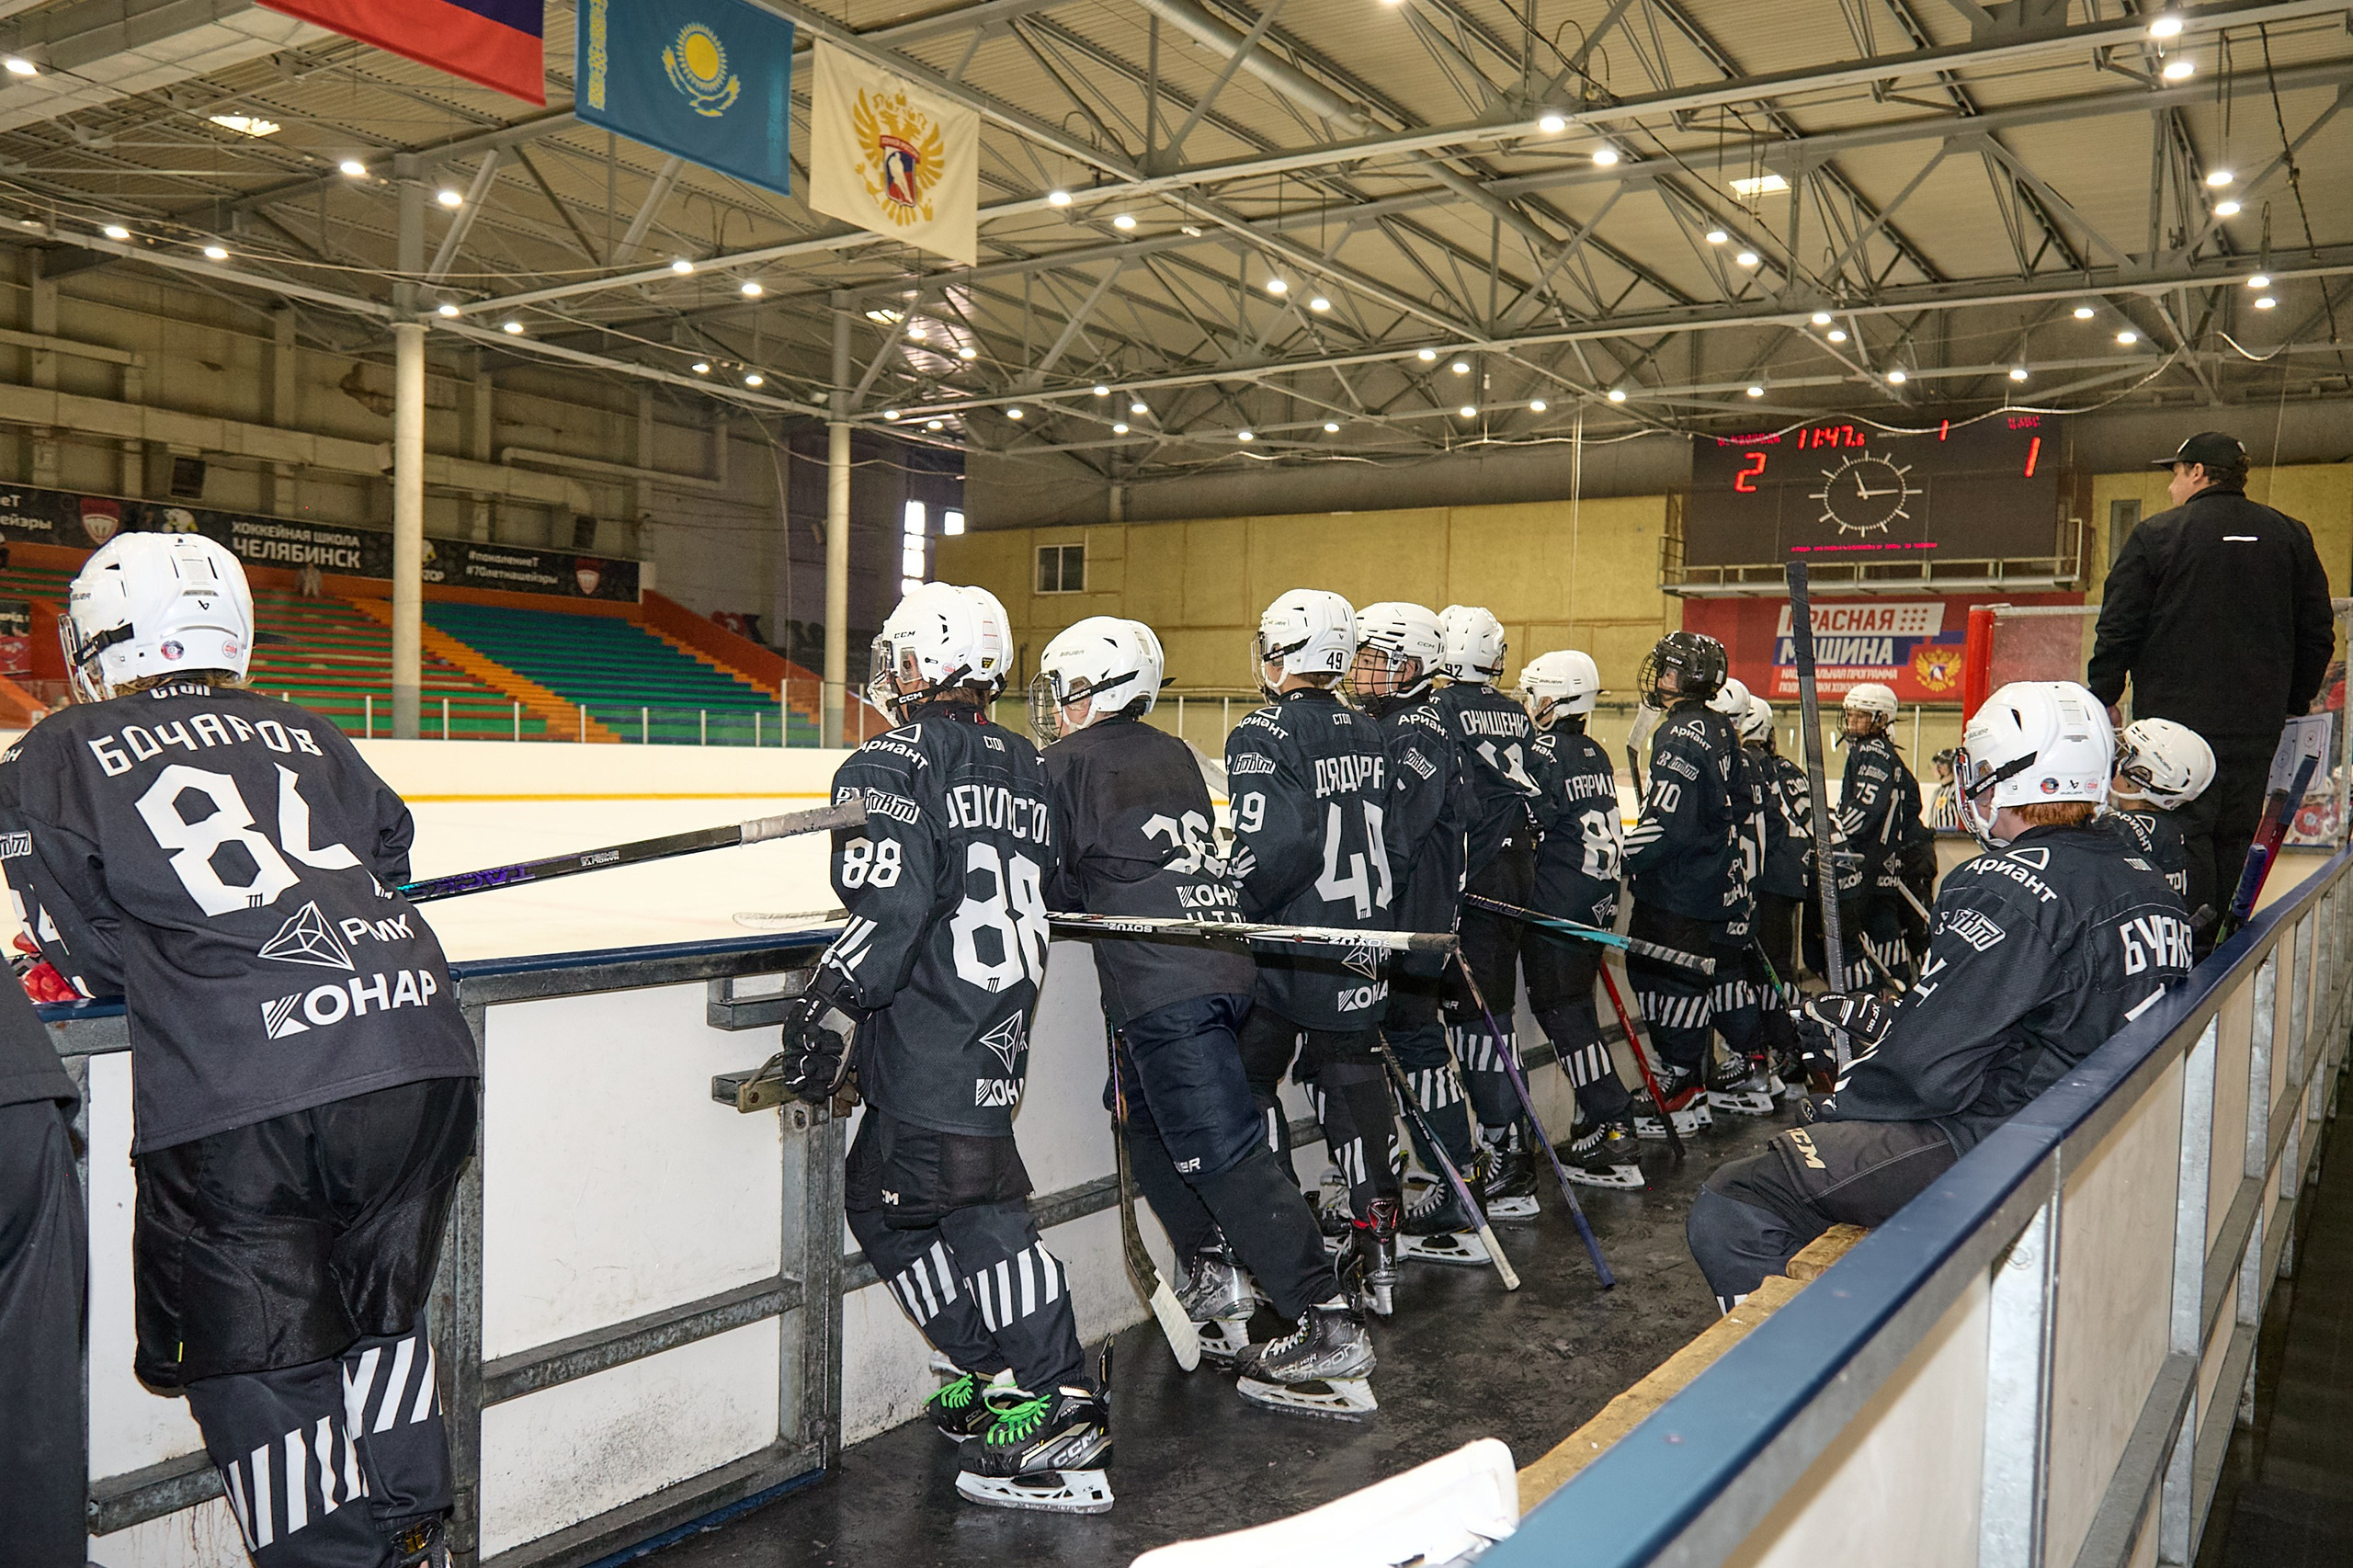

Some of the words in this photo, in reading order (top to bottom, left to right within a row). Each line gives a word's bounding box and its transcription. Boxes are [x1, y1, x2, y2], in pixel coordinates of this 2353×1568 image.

[1938, 419, 1949, 441] 1
[2024, 437, 2040, 477] 1
[1734, 451, 1767, 493] 2
[232, 521, 312, 542] ХОККЕЙНАЯ
[313, 531, 361, 548] ШКОЛА
[233, 537, 361, 569] ЧЕЛЯБИНСК
[1786, 608, 1895, 631] РАСНАЯ
[893, 630, 916, 640] CCM
[1326, 652, 1344, 670] 49
[1779, 637, 1893, 665] МШИНА
[1847, 668, 1898, 680] ПРОГРАММА
[898, 691, 923, 704] CCM
[88, 713, 324, 778] БОЧАРОВ
[1669, 725, 1712, 751] Ариант
[1856, 781, 1880, 805] 75
[581, 856, 620, 867] NANOLITE
[841, 836, 903, 889] 88
[1964, 858, 2059, 903] Ариант
[1108, 923, 1153, 934] SOYUZ
[261, 970, 438, 1040] КОНАР
[965, 1408, 983, 1423] CCM
[1051, 1426, 1100, 1469] CCM
